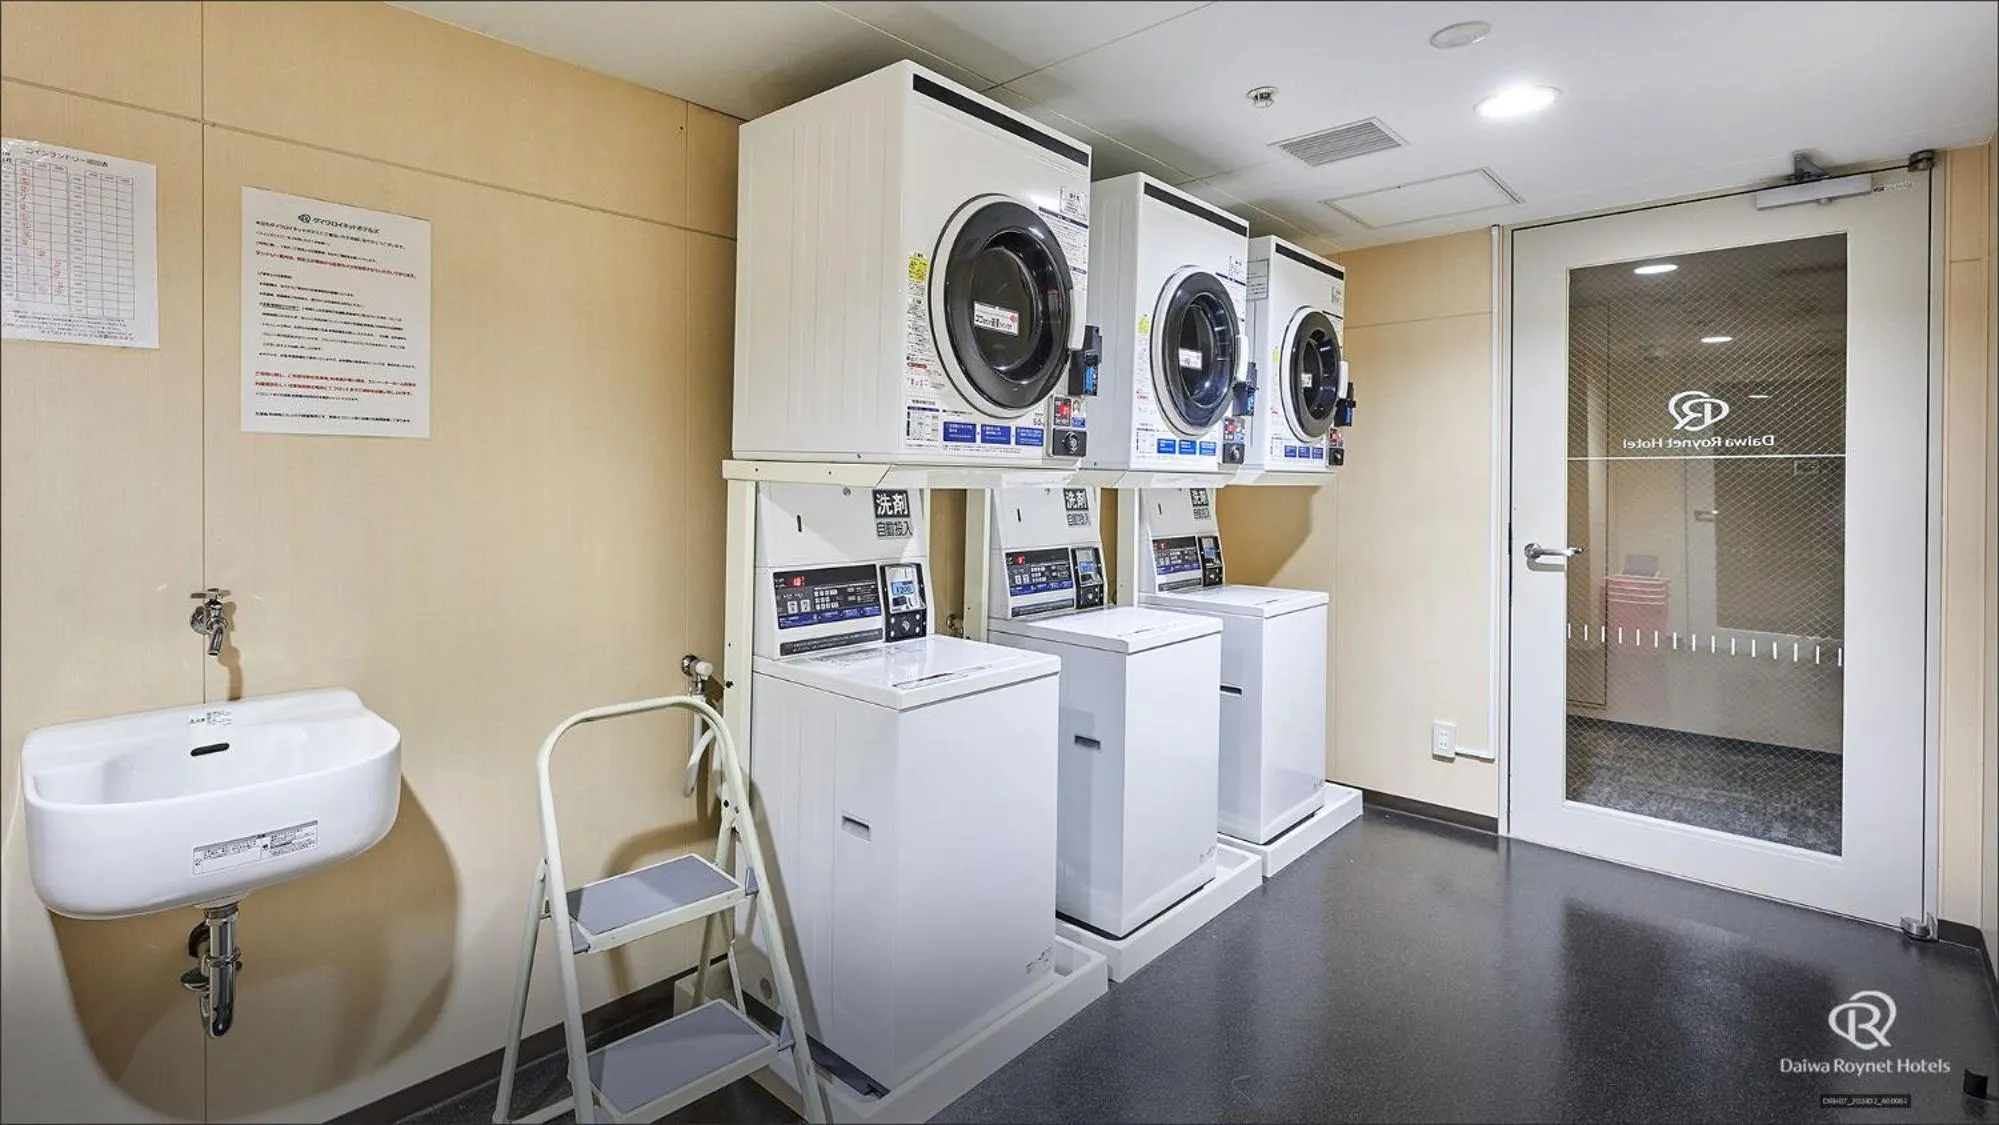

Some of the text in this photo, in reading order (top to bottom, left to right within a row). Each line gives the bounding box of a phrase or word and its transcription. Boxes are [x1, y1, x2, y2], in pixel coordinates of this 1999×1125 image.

[876, 492, 908, 515] 洗剤
[876, 520, 914, 537] 自動投入
